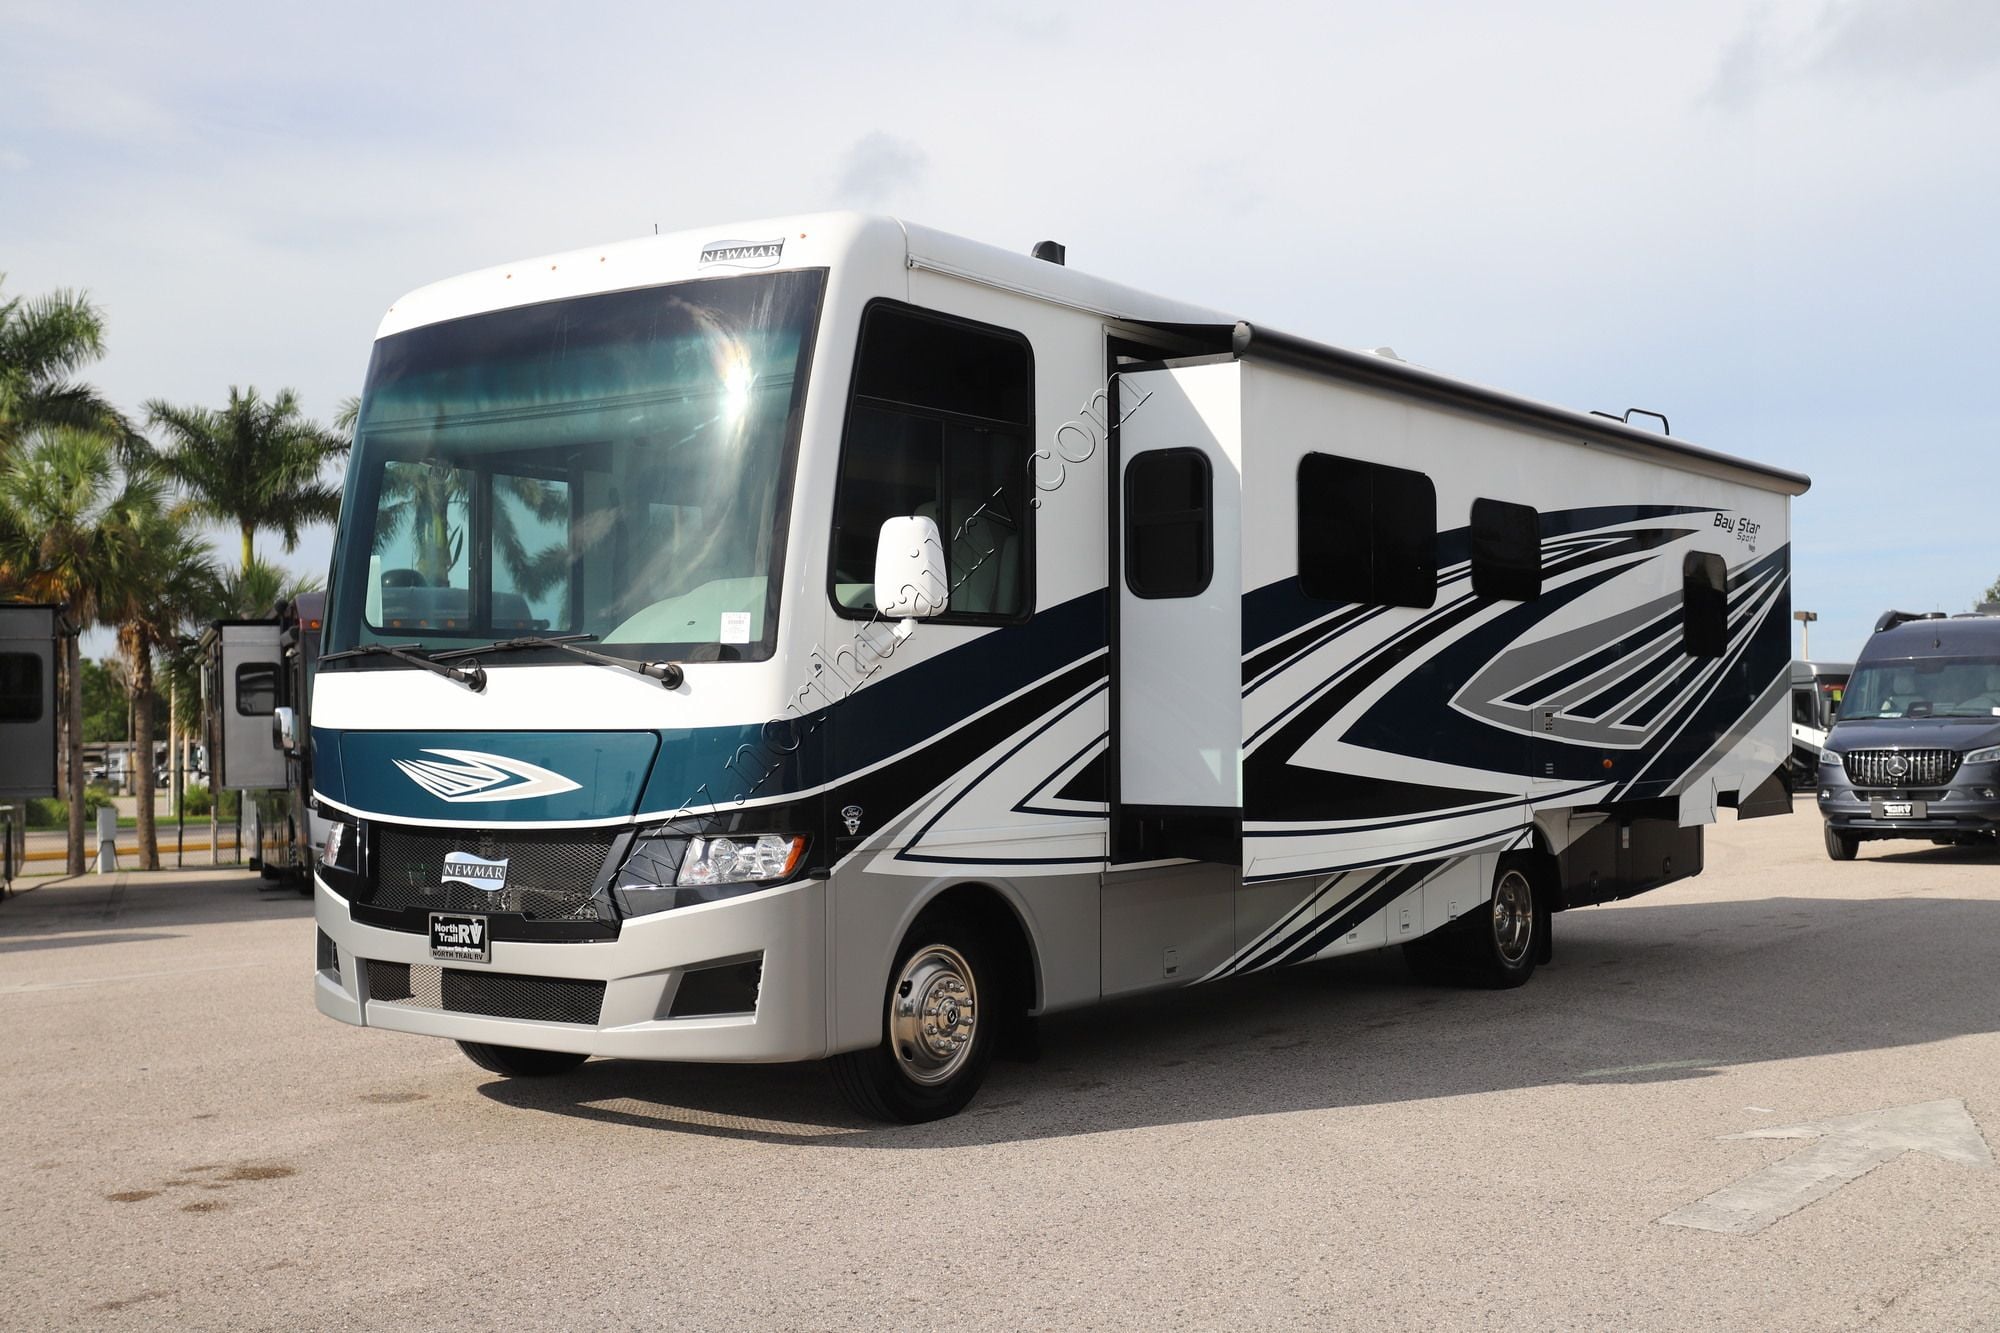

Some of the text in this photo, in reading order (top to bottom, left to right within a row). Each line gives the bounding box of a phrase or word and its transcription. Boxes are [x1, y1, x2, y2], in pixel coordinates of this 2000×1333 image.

[701, 245, 778, 263] NEWMAR
[1713, 512, 1761, 534] Bay Star
[1736, 531, 1756, 543] Sport
[444, 864, 504, 879] NEWMAR
[434, 922, 458, 933] North
[458, 922, 483, 945] RV
[438, 932, 458, 943] Trail
[432, 950, 454, 958] NORTH
